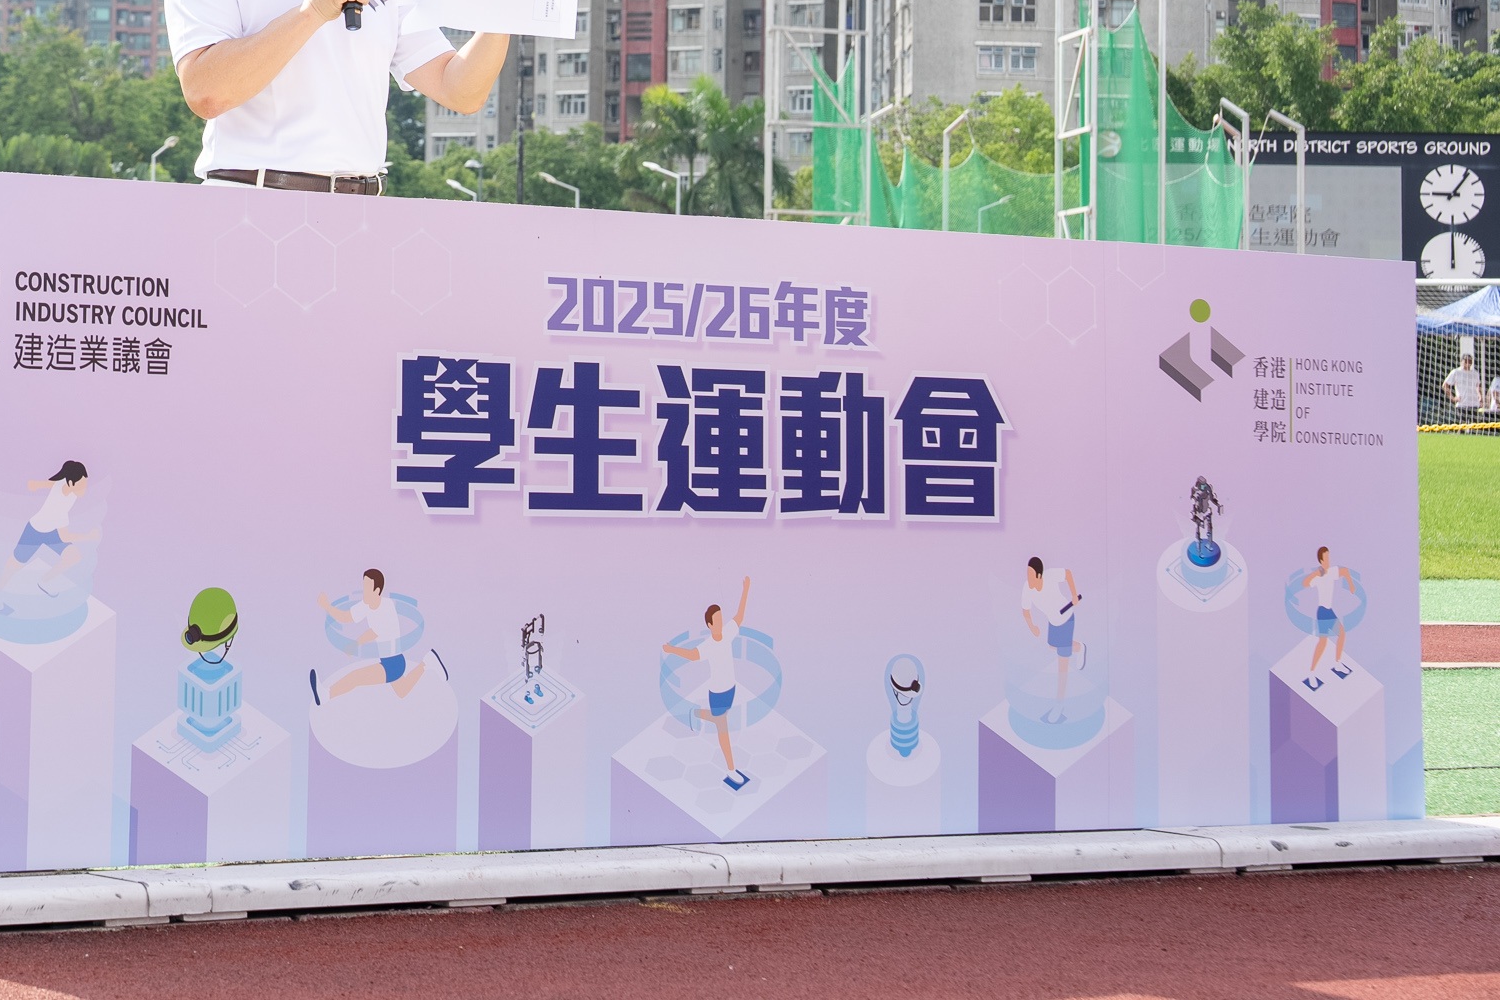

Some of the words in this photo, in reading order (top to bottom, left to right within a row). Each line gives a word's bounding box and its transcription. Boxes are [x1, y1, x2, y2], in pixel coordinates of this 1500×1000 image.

[1227, 138, 1278, 153] NRTH
[1356, 139, 1418, 155] SPORTS
[1424, 140, 1491, 156] GROUND
[15, 271, 170, 297] CONSTRUCTION
[15, 301, 116, 325] INDUSTRY
[121, 305, 208, 328] COUNCIL
[546, 276, 870, 347] 2025/26年度
[13, 332, 173, 375] 建造業議會
[1253, 356, 1286, 379] 香港
[1295, 358, 1328, 372] HONG
[1331, 360, 1363, 374] KONG
[1253, 388, 1286, 411] 建造
[1295, 382, 1354, 397] INSTITUTE
[1295, 406, 1310, 419] OF
[396, 355, 1006, 517] 學生運動會
[1253, 420, 1286, 443] 學院
[1295, 431, 1384, 446] CONSTRUCTION
